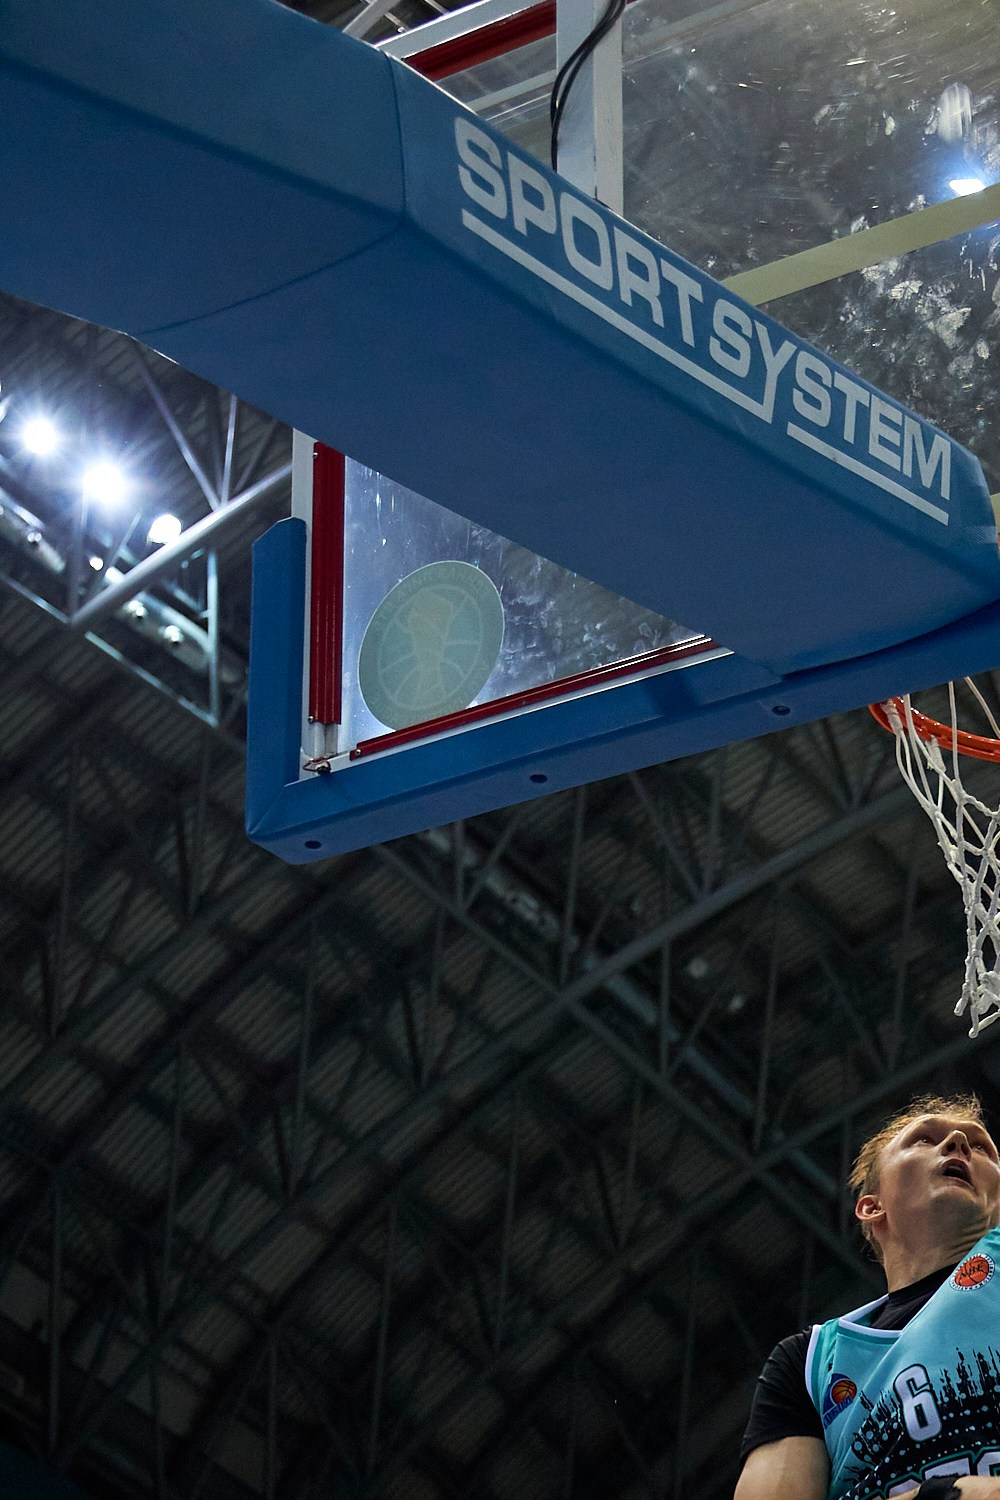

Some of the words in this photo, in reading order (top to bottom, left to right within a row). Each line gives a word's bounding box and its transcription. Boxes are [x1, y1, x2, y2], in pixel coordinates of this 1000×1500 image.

[454, 116, 703, 348] SPORT
[709, 301, 952, 500] SYSTEM
[893, 1363, 942, 1442] 6
